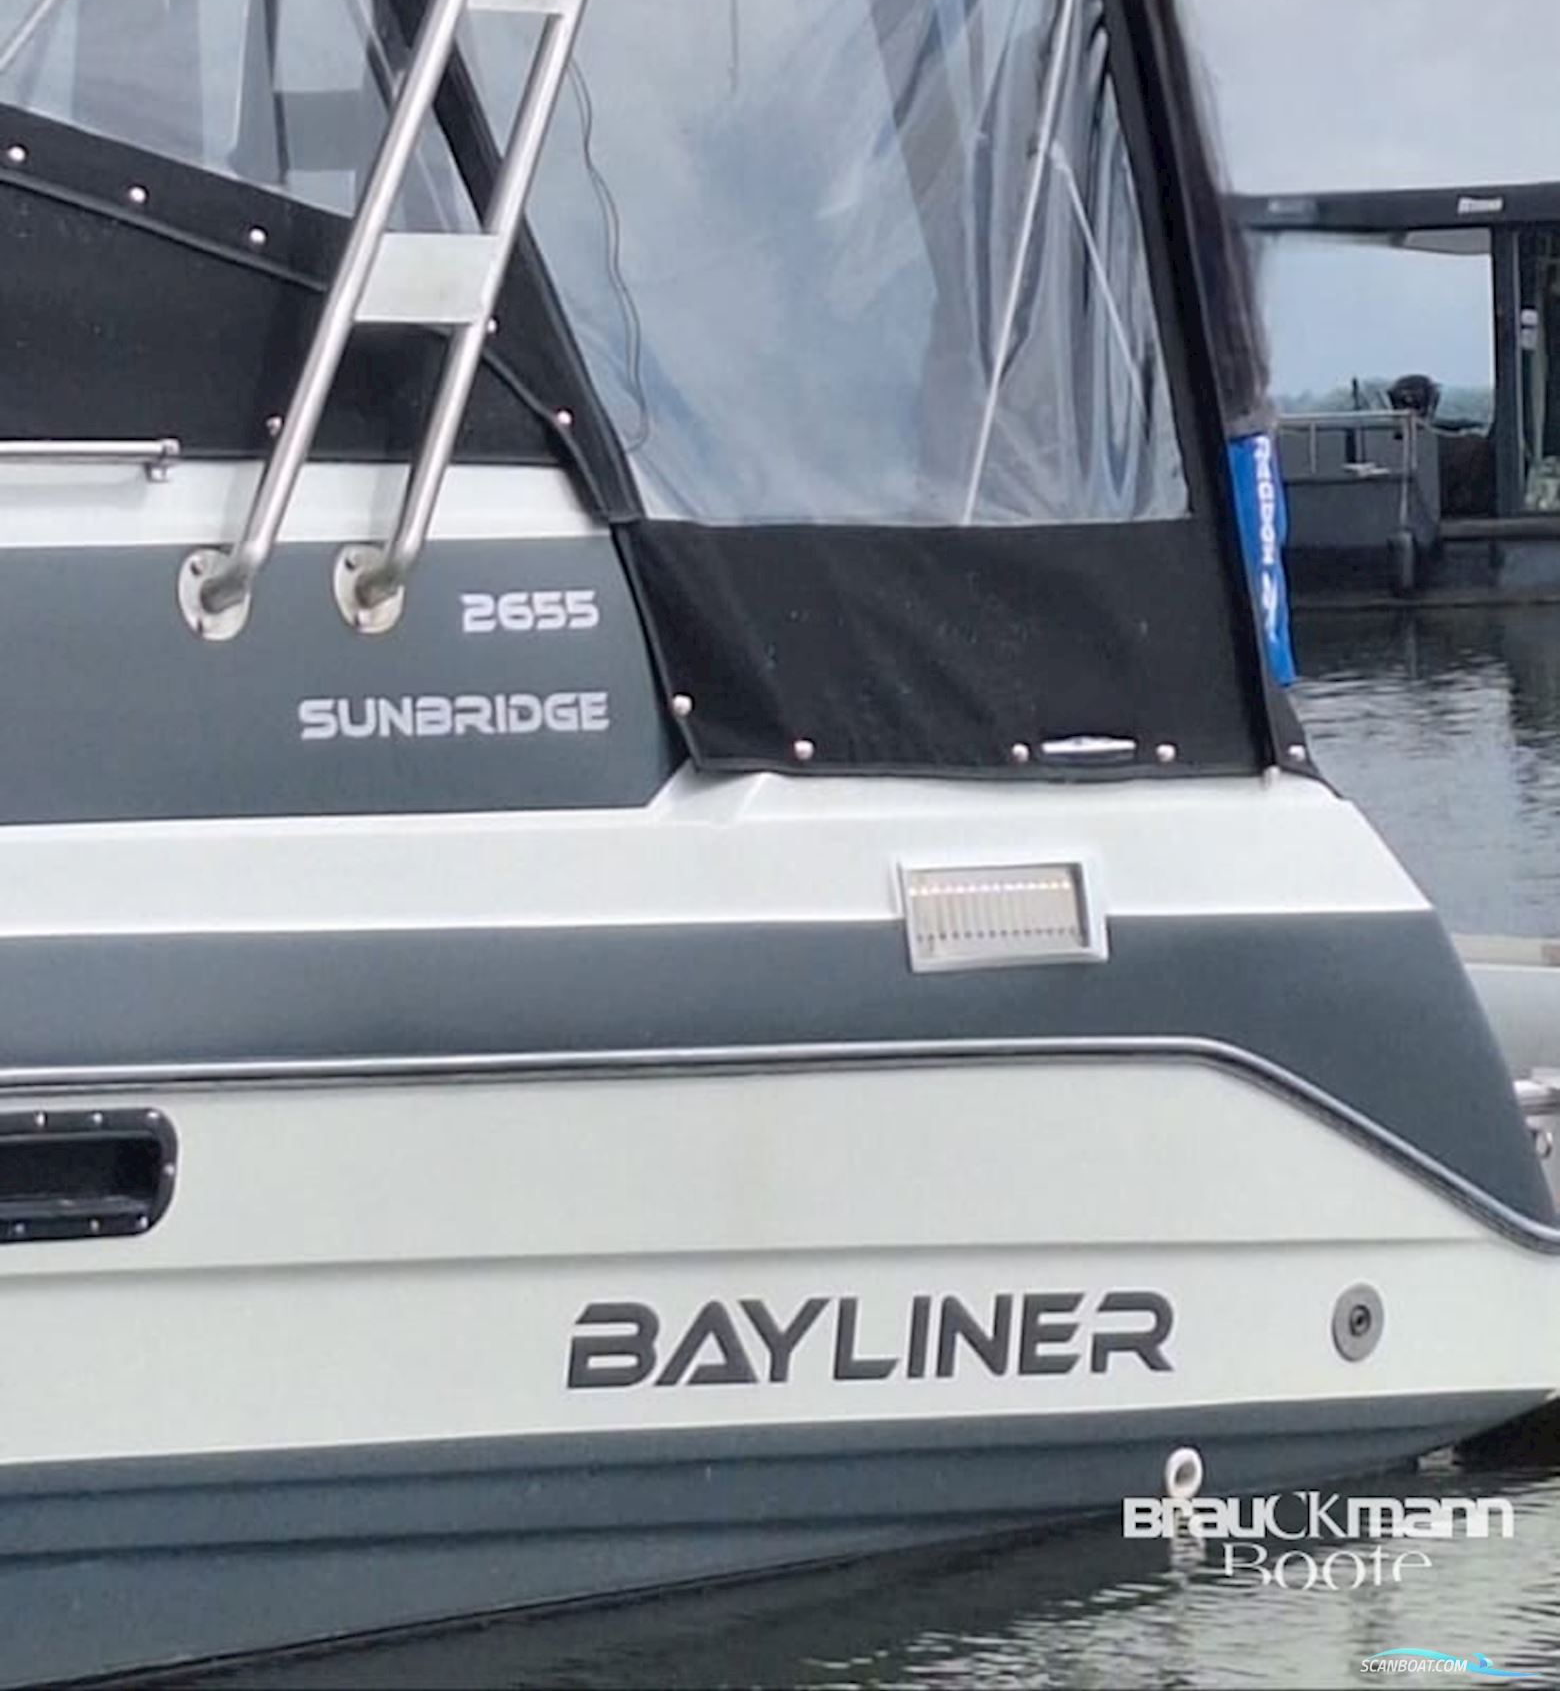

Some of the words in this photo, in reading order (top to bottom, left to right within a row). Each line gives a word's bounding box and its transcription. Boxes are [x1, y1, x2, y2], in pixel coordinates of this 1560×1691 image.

[461, 590, 599, 632] 2655
[299, 692, 610, 739] SUNBRIDGE
[567, 1291, 1174, 1389] BAYLINER
